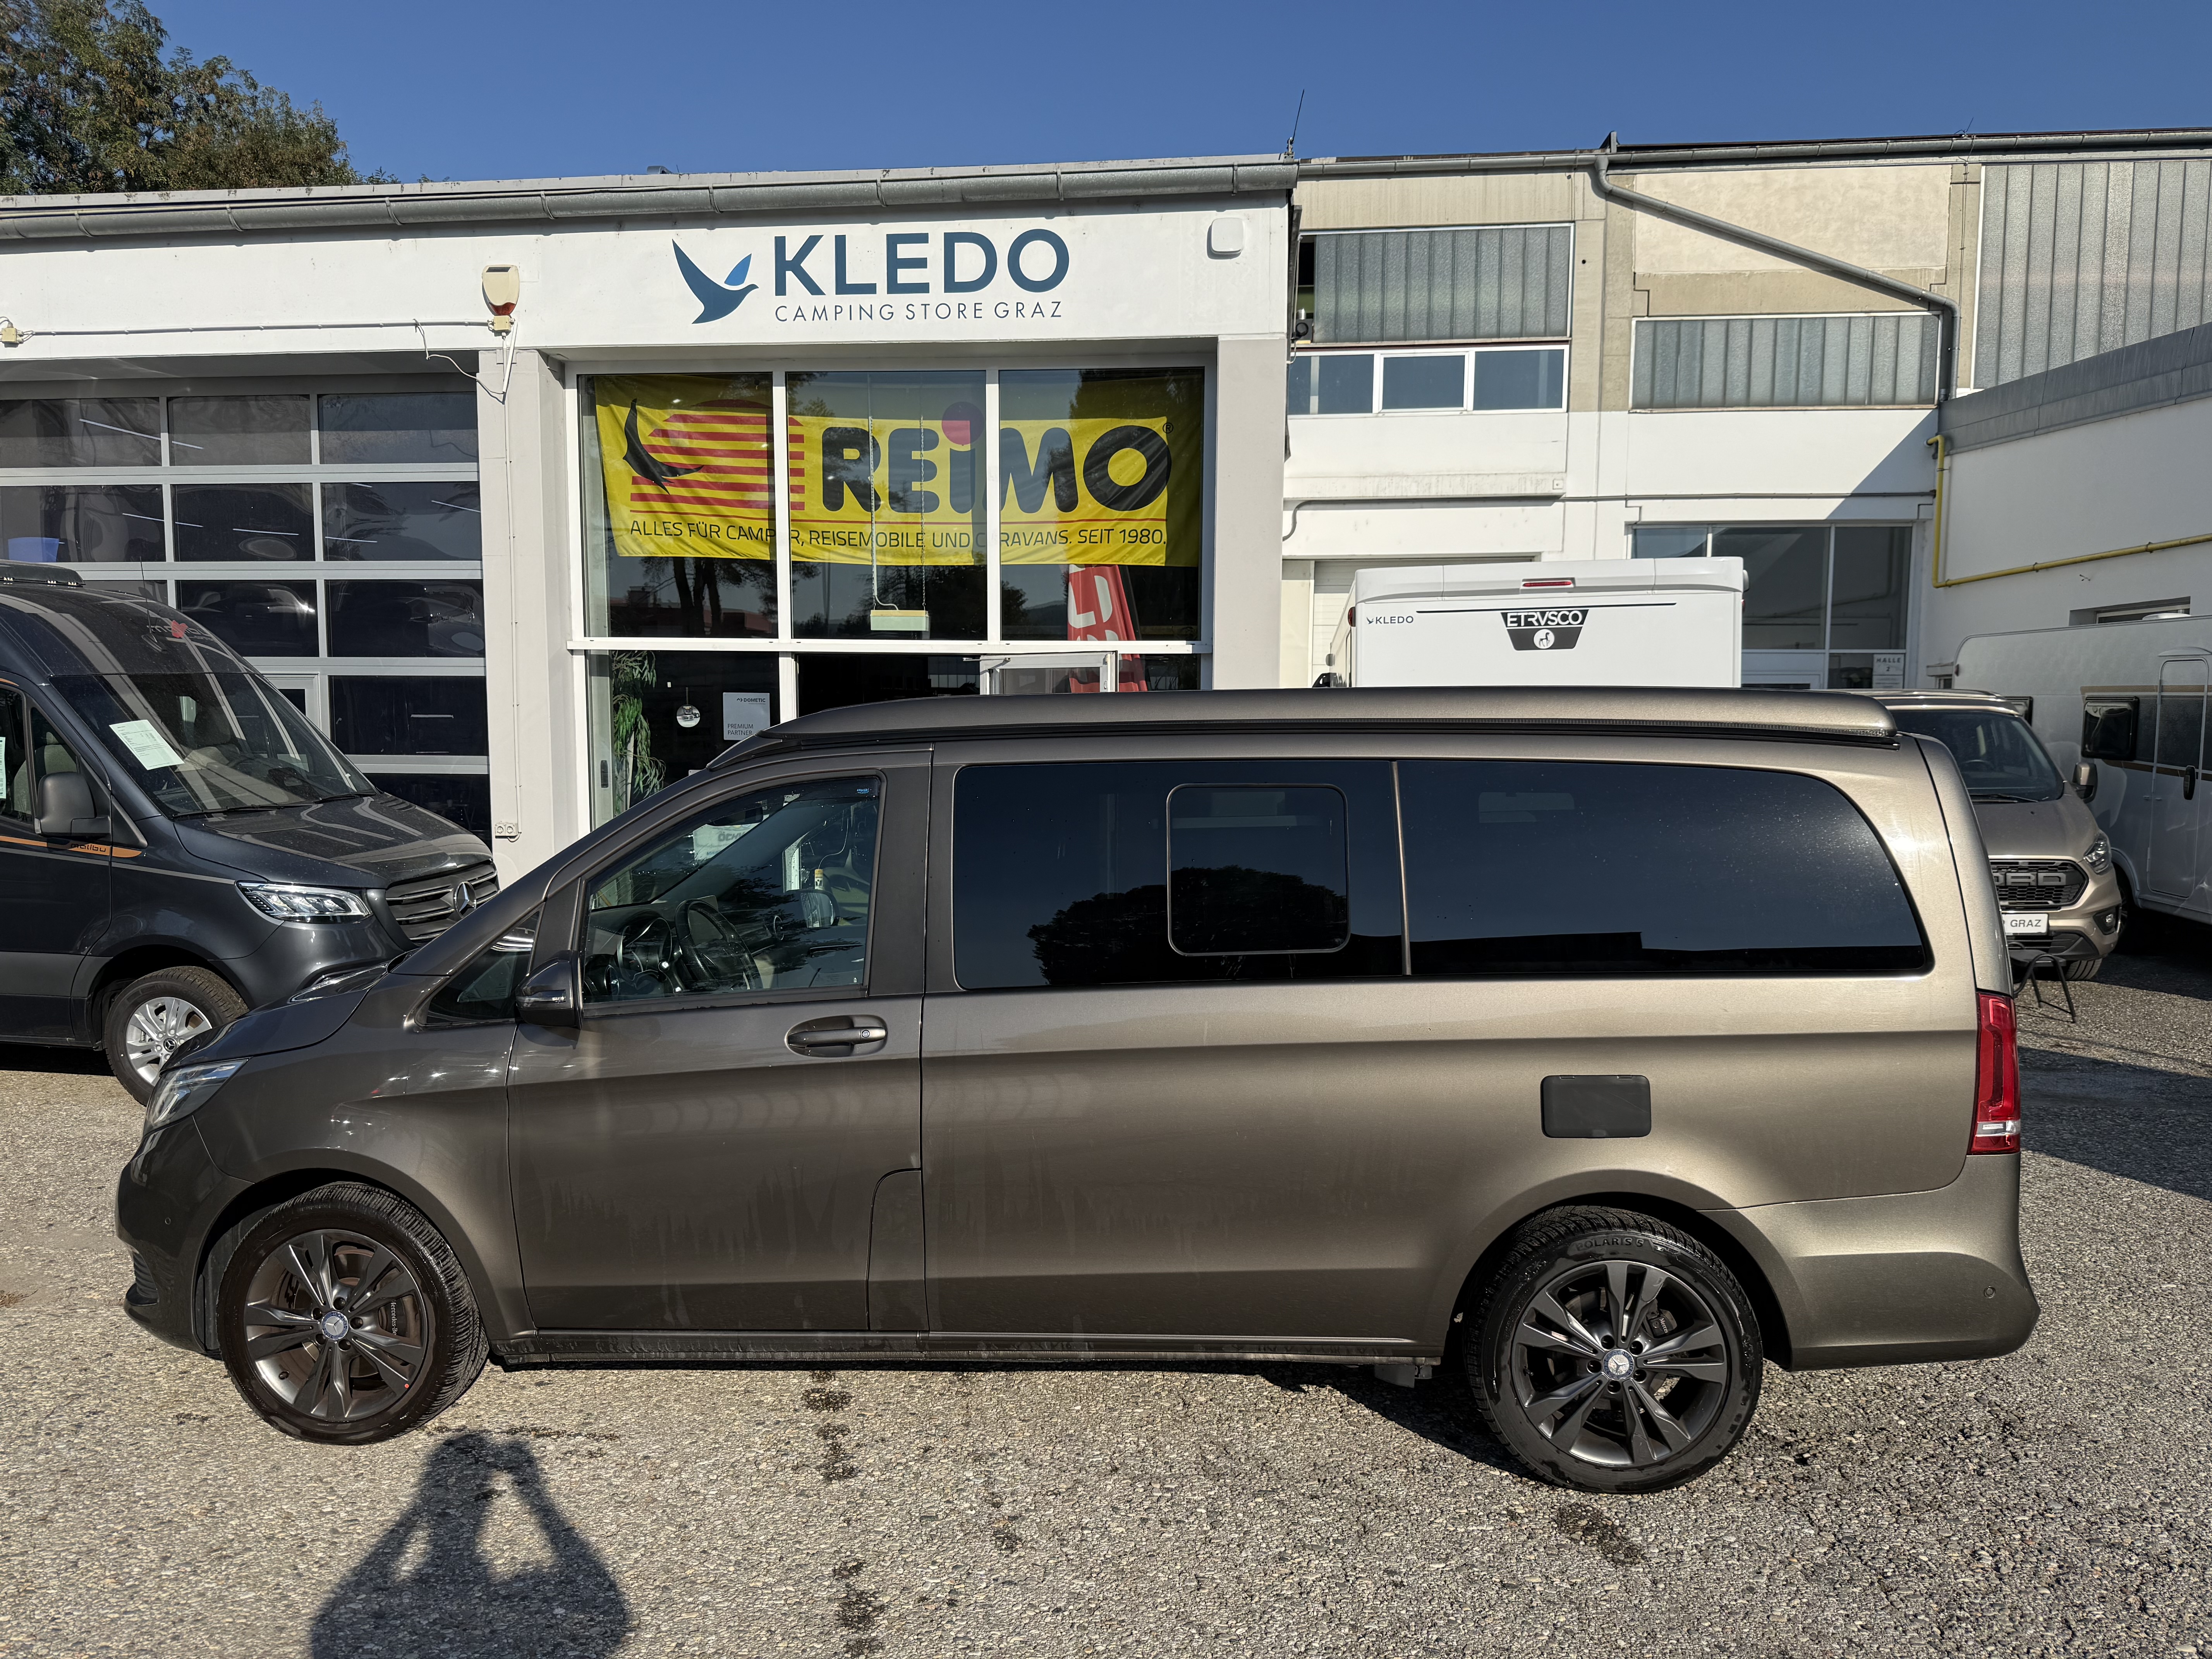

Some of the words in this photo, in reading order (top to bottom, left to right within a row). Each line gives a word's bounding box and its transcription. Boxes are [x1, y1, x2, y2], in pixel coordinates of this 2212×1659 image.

[775, 228, 1069, 296] KLEDO
[775, 304, 895, 322] CAMPING
[905, 302, 983, 320] STORE
[994, 301, 1062, 319] GRAZ
[630, 520, 683, 537] ALLES
[687, 520, 721, 539] FÜR
[726, 525, 804, 547] CAMPR,
[809, 530, 926, 548] REISEMOBILE
[932, 532, 970, 548] UND
[975, 530, 1072, 548] CRAVANS.
[1077, 529, 1115, 544] SEIT
[1119, 528, 1167, 544] 1980.
[1376, 616, 1414, 624] KLEDO
[71, 843, 106, 852] malibu
[2010, 919, 2042, 927] GRAZ
[1576, 1238, 1632, 1251] POLARIS
[1636, 1239, 1644, 1247] 5
